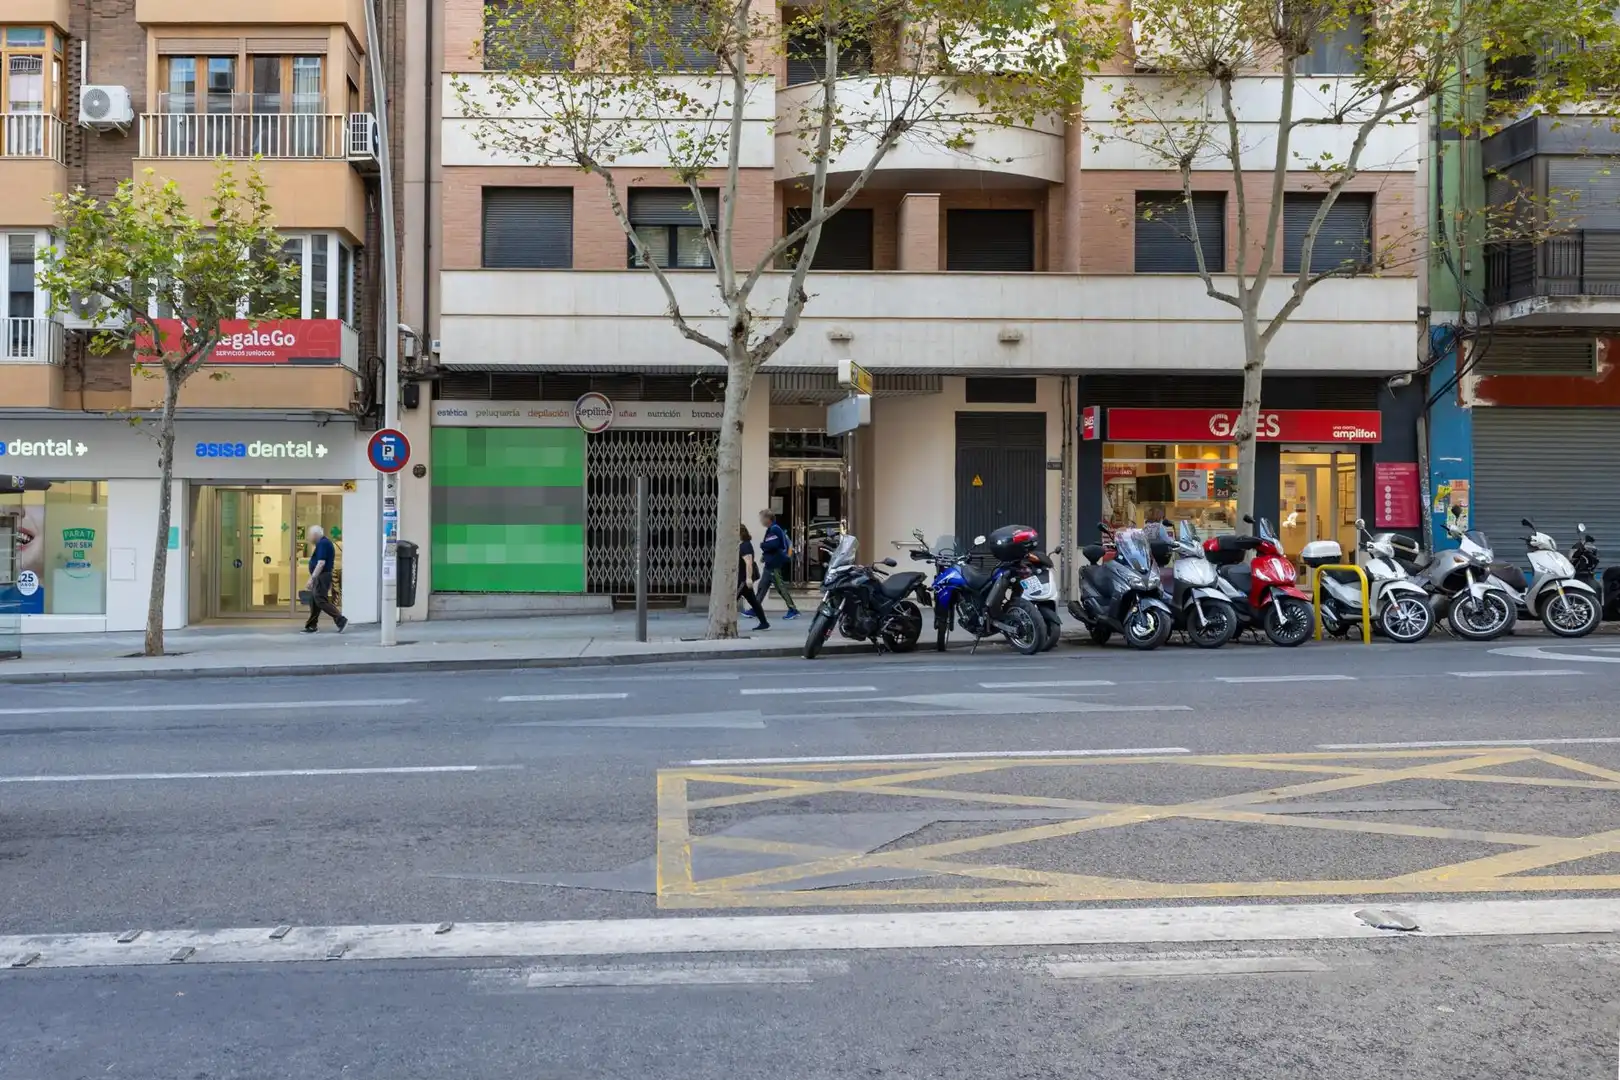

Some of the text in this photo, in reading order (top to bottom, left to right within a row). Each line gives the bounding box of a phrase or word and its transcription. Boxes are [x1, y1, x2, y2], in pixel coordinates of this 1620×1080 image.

[216, 330, 296, 350] egaleGo
[437, 407, 570, 419] estética peluquería depilación
[619, 410, 637, 418] uñas
[647, 410, 681, 418] nutrición
[1333, 428, 1377, 440] amplifon
[8, 438, 73, 456] dental
[195, 440, 313, 457] asisa dental
[384, 446, 392, 455] P
[21, 573, 34, 583] 25
